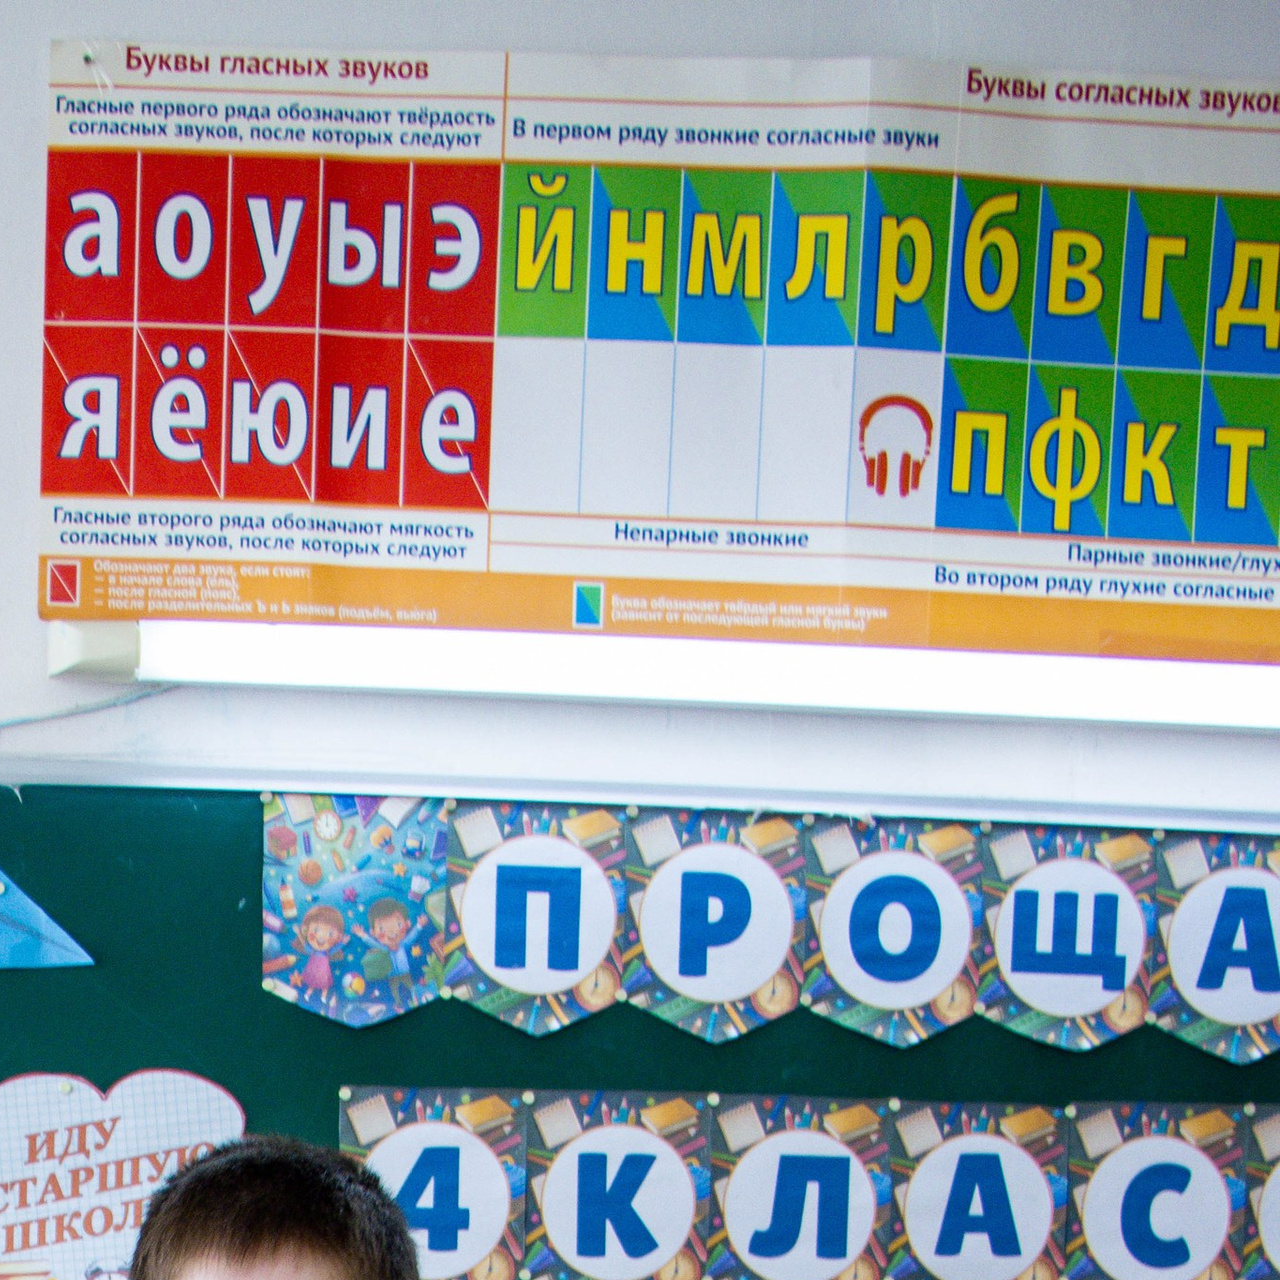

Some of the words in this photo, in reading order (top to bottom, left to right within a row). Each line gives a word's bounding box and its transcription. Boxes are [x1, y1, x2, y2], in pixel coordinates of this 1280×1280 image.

[125, 46, 210, 77] Буквы
[219, 54, 329, 78] гласных
[338, 59, 430, 85] звуков
[966, 67, 1047, 102] Буквы
[1054, 80, 1191, 110] согласных
[55, 94, 135, 116] Гласные
[140, 101, 218, 119] первого
[224, 104, 270, 122] ряда
[276, 103, 392, 124] обозначают
[397, 107, 496, 130] твёрдость
[68, 119, 168, 137] согласных
[173, 122, 244, 142] звуков,
[249, 126, 306, 143] после
[312, 127, 394, 149] которых
[399, 130, 482, 151] следуют
[512, 117, 526, 138] В
[532, 122, 612, 145] первом
[618, 124, 668, 147] ряду
[674, 127, 760, 145] звонкие
[766, 128, 876, 147] согласные
[881, 129, 940, 151] звуки
[61, 188, 121, 279] а
[153, 191, 215, 281] о
[244, 194, 308, 318] у
[324, 199, 404, 291] ы
[426, 201, 484, 292] э
[512, 172, 576, 294] й
[604, 206, 668, 296] н
[684, 209, 766, 302] м
[784, 212, 851, 302] л
[872, 213, 935, 336] р
[961, 190, 1022, 315] б
[1044, 228, 1106, 318] в
[1140, 235, 1188, 325] г
[58, 373, 122, 462] я
[149, 342, 210, 463] ё
[229, 378, 310, 468] ю
[329, 382, 391, 472] и
[418, 387, 478, 475] е
[949, 408, 1010, 497] п
[1027, 386, 1103, 534] ф
[1121, 421, 1179, 509] к
[1214, 424, 1268, 512] т
[53, 505, 132, 527] Гласные
[137, 511, 214, 532] второго
[219, 515, 266, 534] ряда
[271, 513, 384, 536] обозначают
[388, 522, 476, 541] мягкость
[613, 521, 719, 547] Непарные
[724, 530, 810, 549] звонкие
[58, 531, 159, 547] согласных
[164, 534, 234, 552] звуков,
[239, 535, 296, 552] после
[301, 537, 381, 560] которых
[386, 543, 468, 563] следуют
[1066, 543, 1146, 568] Парные
[933, 564, 960, 585] Во
[966, 571, 1039, 592] втором
[1045, 575, 1093, 597] ряду
[1099, 577, 1167, 599] глухие
[1173, 580, 1276, 602] согласные
[23, 1116, 122, 1166] ИДУ
[397, 1145, 471, 1254] 4
[2, 1195, 154, 1255] ШКОЛ
